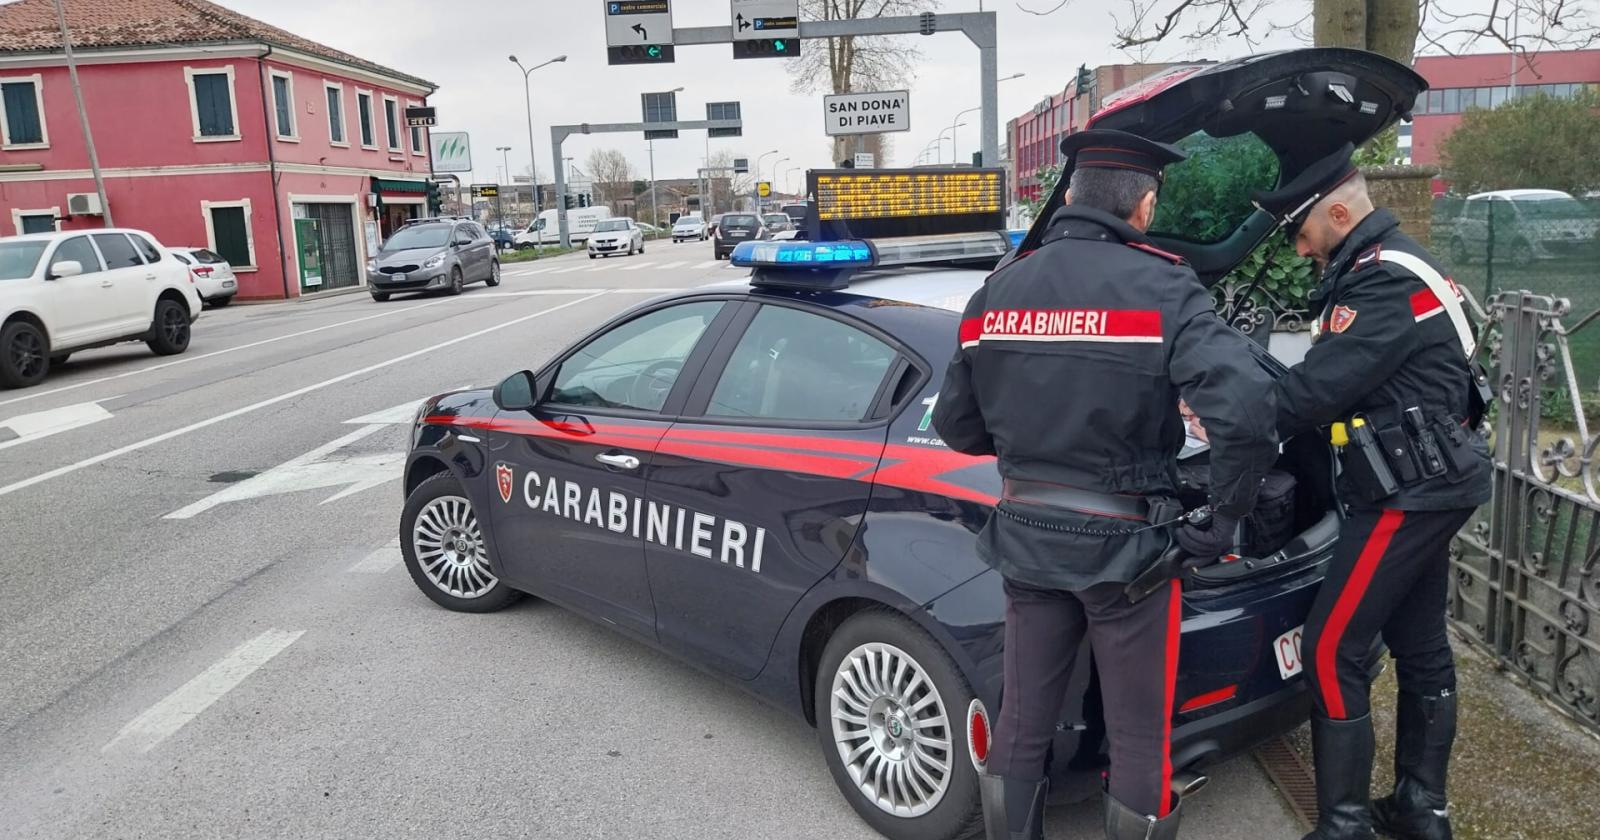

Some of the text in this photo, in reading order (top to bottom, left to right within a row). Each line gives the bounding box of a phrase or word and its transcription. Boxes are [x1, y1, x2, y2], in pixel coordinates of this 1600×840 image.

[829, 98, 904, 113] SAN DONA'
[839, 113, 896, 127] DI PIAVE
[983, 311, 1108, 335] CARABINIERI
[523, 470, 766, 573] CARABINIERI
